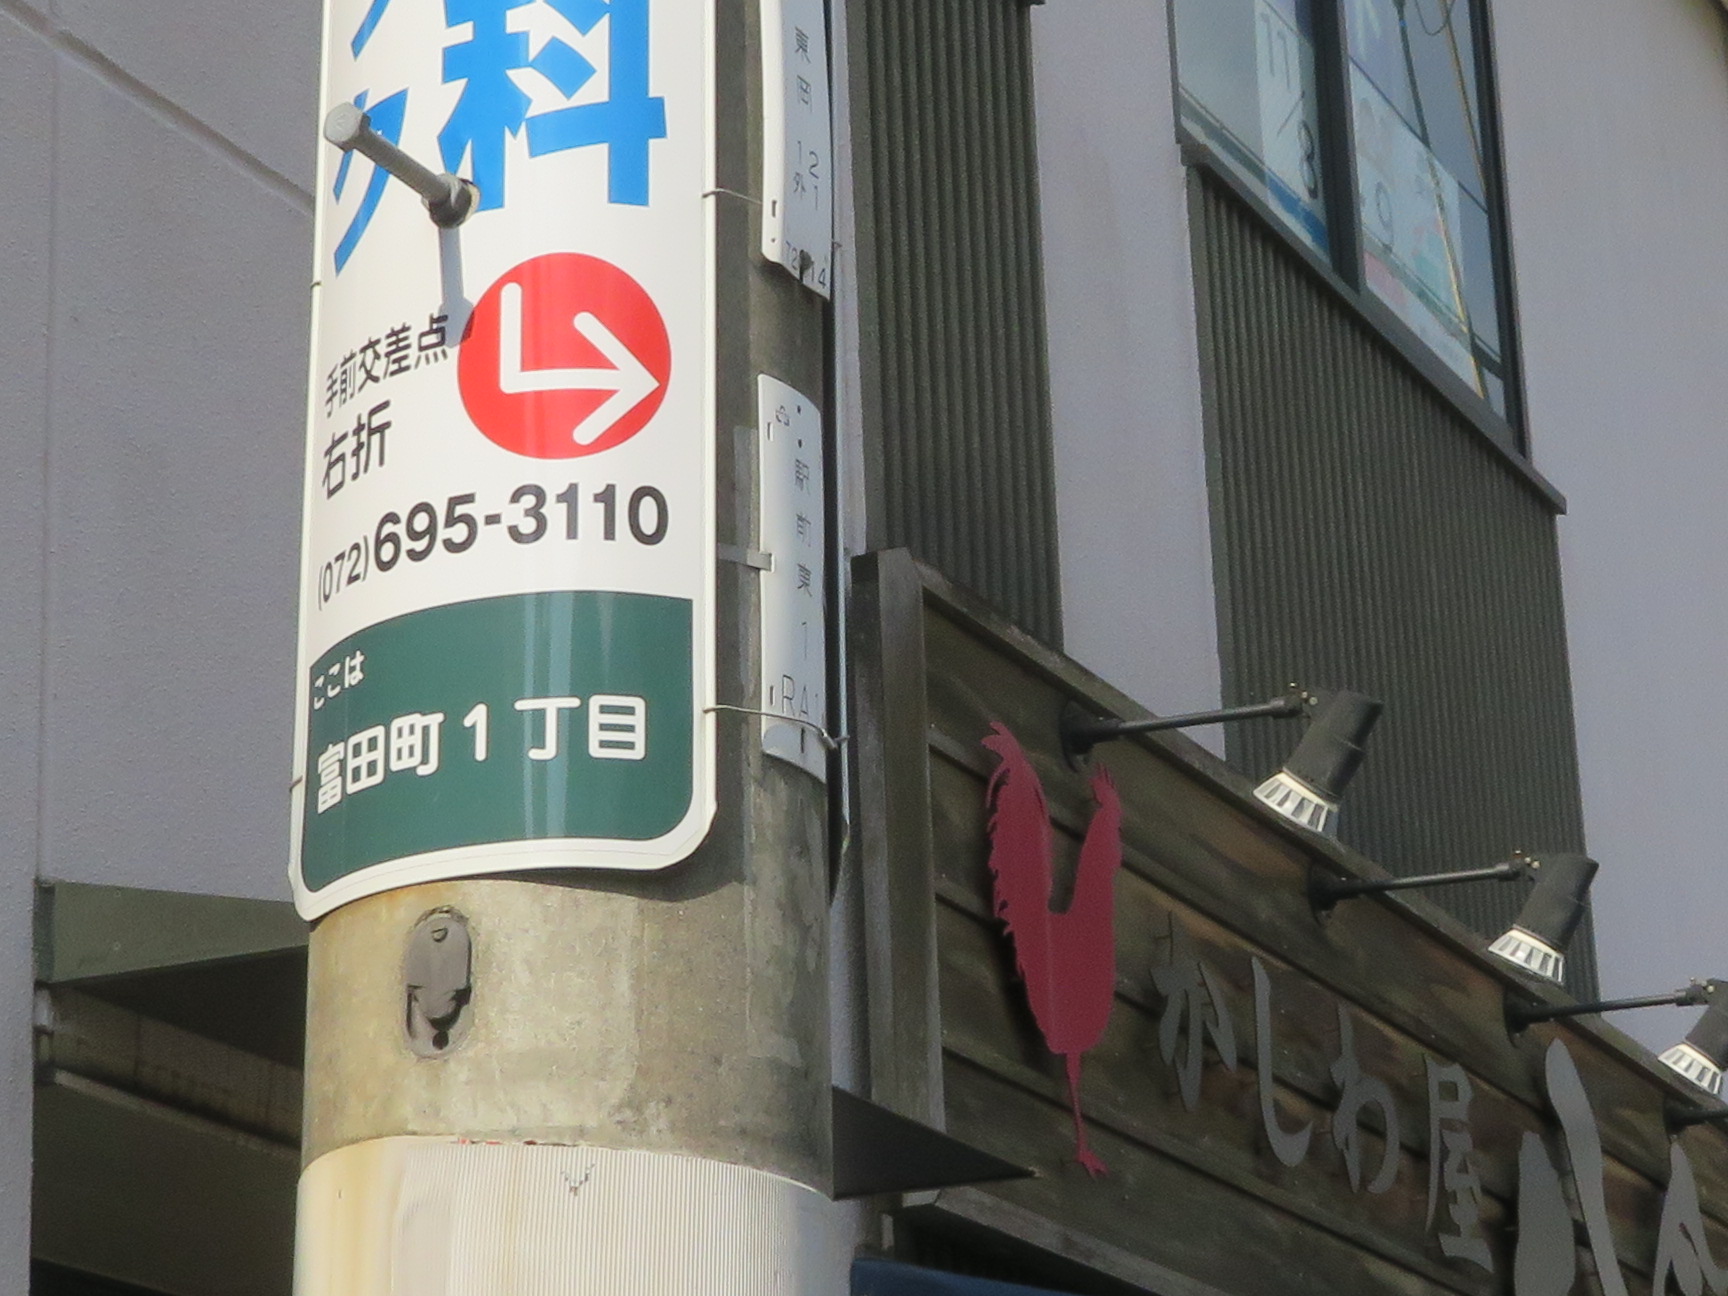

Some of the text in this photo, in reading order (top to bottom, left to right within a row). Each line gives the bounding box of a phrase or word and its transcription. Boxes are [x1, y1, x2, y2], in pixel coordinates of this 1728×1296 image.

[324, 312, 450, 419] 手前交差点
[322, 399, 392, 500] 右折
[318, 482, 669, 611] (072)695-3110
[313, 650, 365, 710] ここは
[1152, 911, 1495, 1275] かしわ屋
